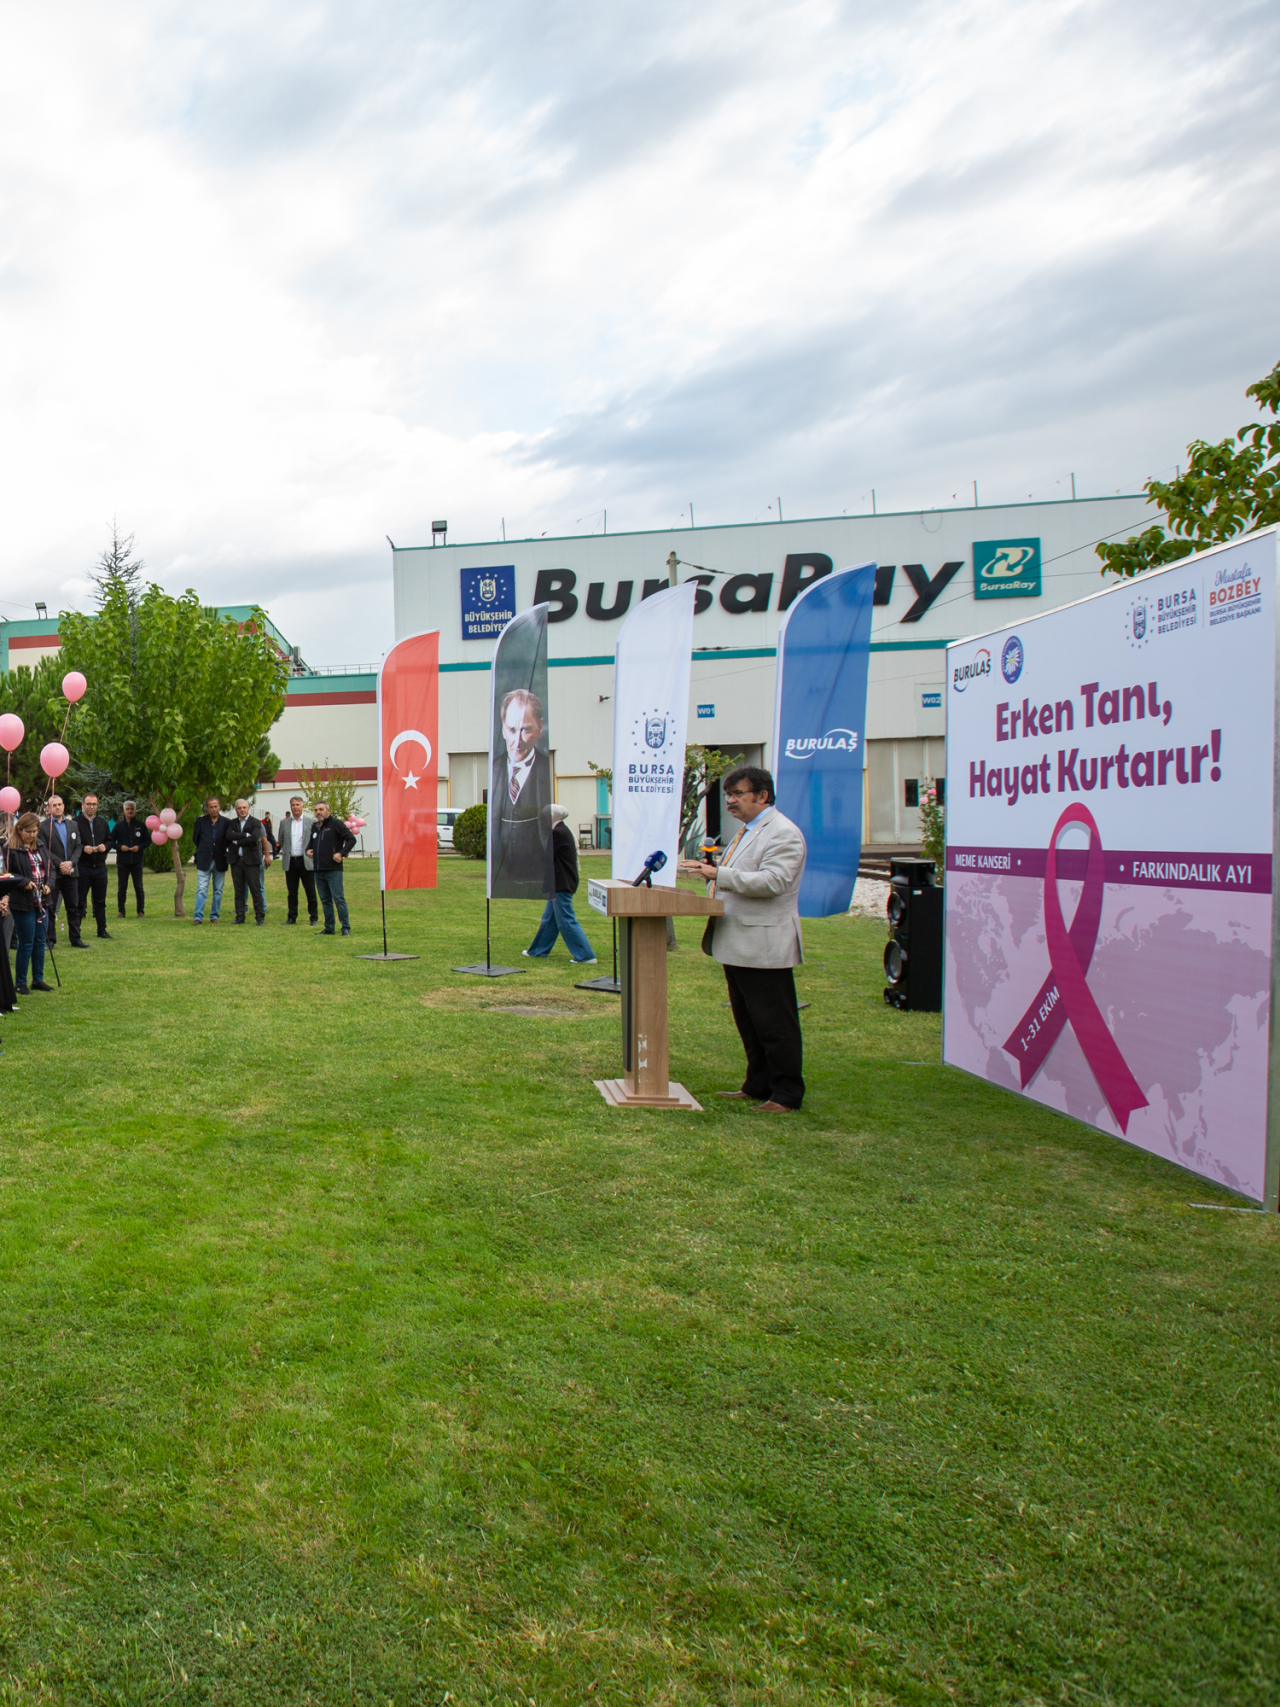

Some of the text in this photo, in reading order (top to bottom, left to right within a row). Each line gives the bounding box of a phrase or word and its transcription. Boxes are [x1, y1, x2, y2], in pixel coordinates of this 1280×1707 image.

[1214, 563, 1253, 586] Mustafa
[980, 581, 1036, 591] BursaRay
[1209, 577, 1261, 606] BOZBEY
[1157, 588, 1197, 612] BURSA
[464, 610, 513, 622] BÜYÜKŞEHİR
[1235, 606, 1262, 619] BAŞKANI
[1157, 613, 1197, 635] BELEDİYESİ
[953, 658, 992, 683] BURULAŞ
[697, 707, 716, 716] W01
[922, 696, 942, 705] W02
[995, 681, 1173, 742] Erken Tanı,
[785, 737, 858, 753] BURULAŞ
[628, 763, 675, 775] BURSA
[969, 728, 1222, 807] Hayat Kurtarır!
[628, 783, 674, 794] BELEDİYESİ
[955, 852, 1252, 884] MEME KANSERİ FARKINDALIK AYI
[1020, 985, 1061, 1052] 1-31 EKİM
